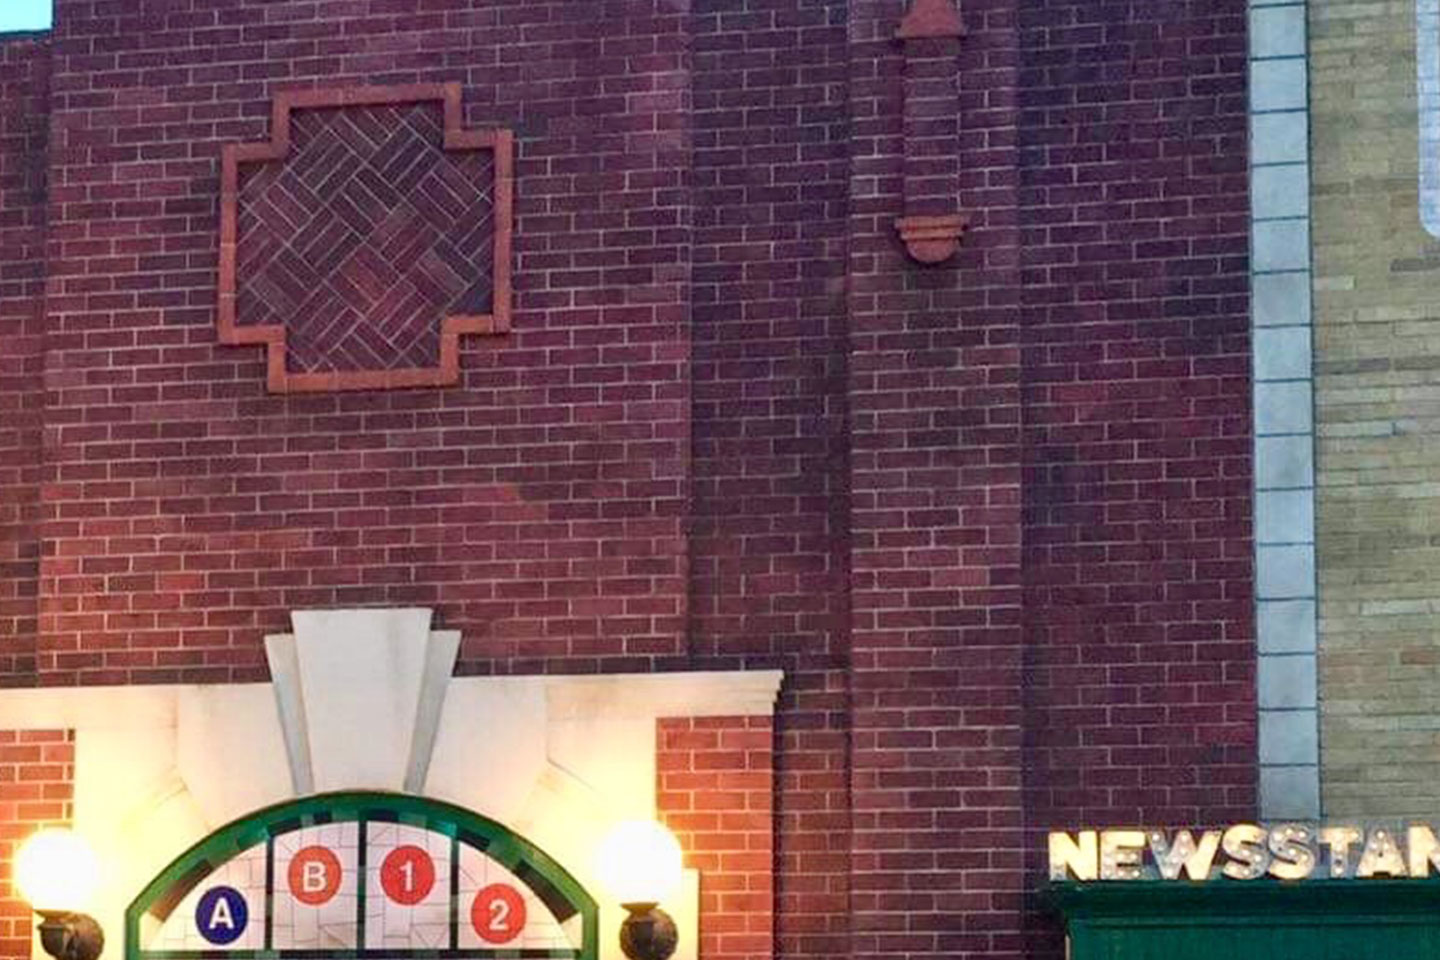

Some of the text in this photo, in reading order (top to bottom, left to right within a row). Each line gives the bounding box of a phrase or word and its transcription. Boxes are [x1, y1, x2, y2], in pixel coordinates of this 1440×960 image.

[208, 861, 509, 930] A B 1 2
